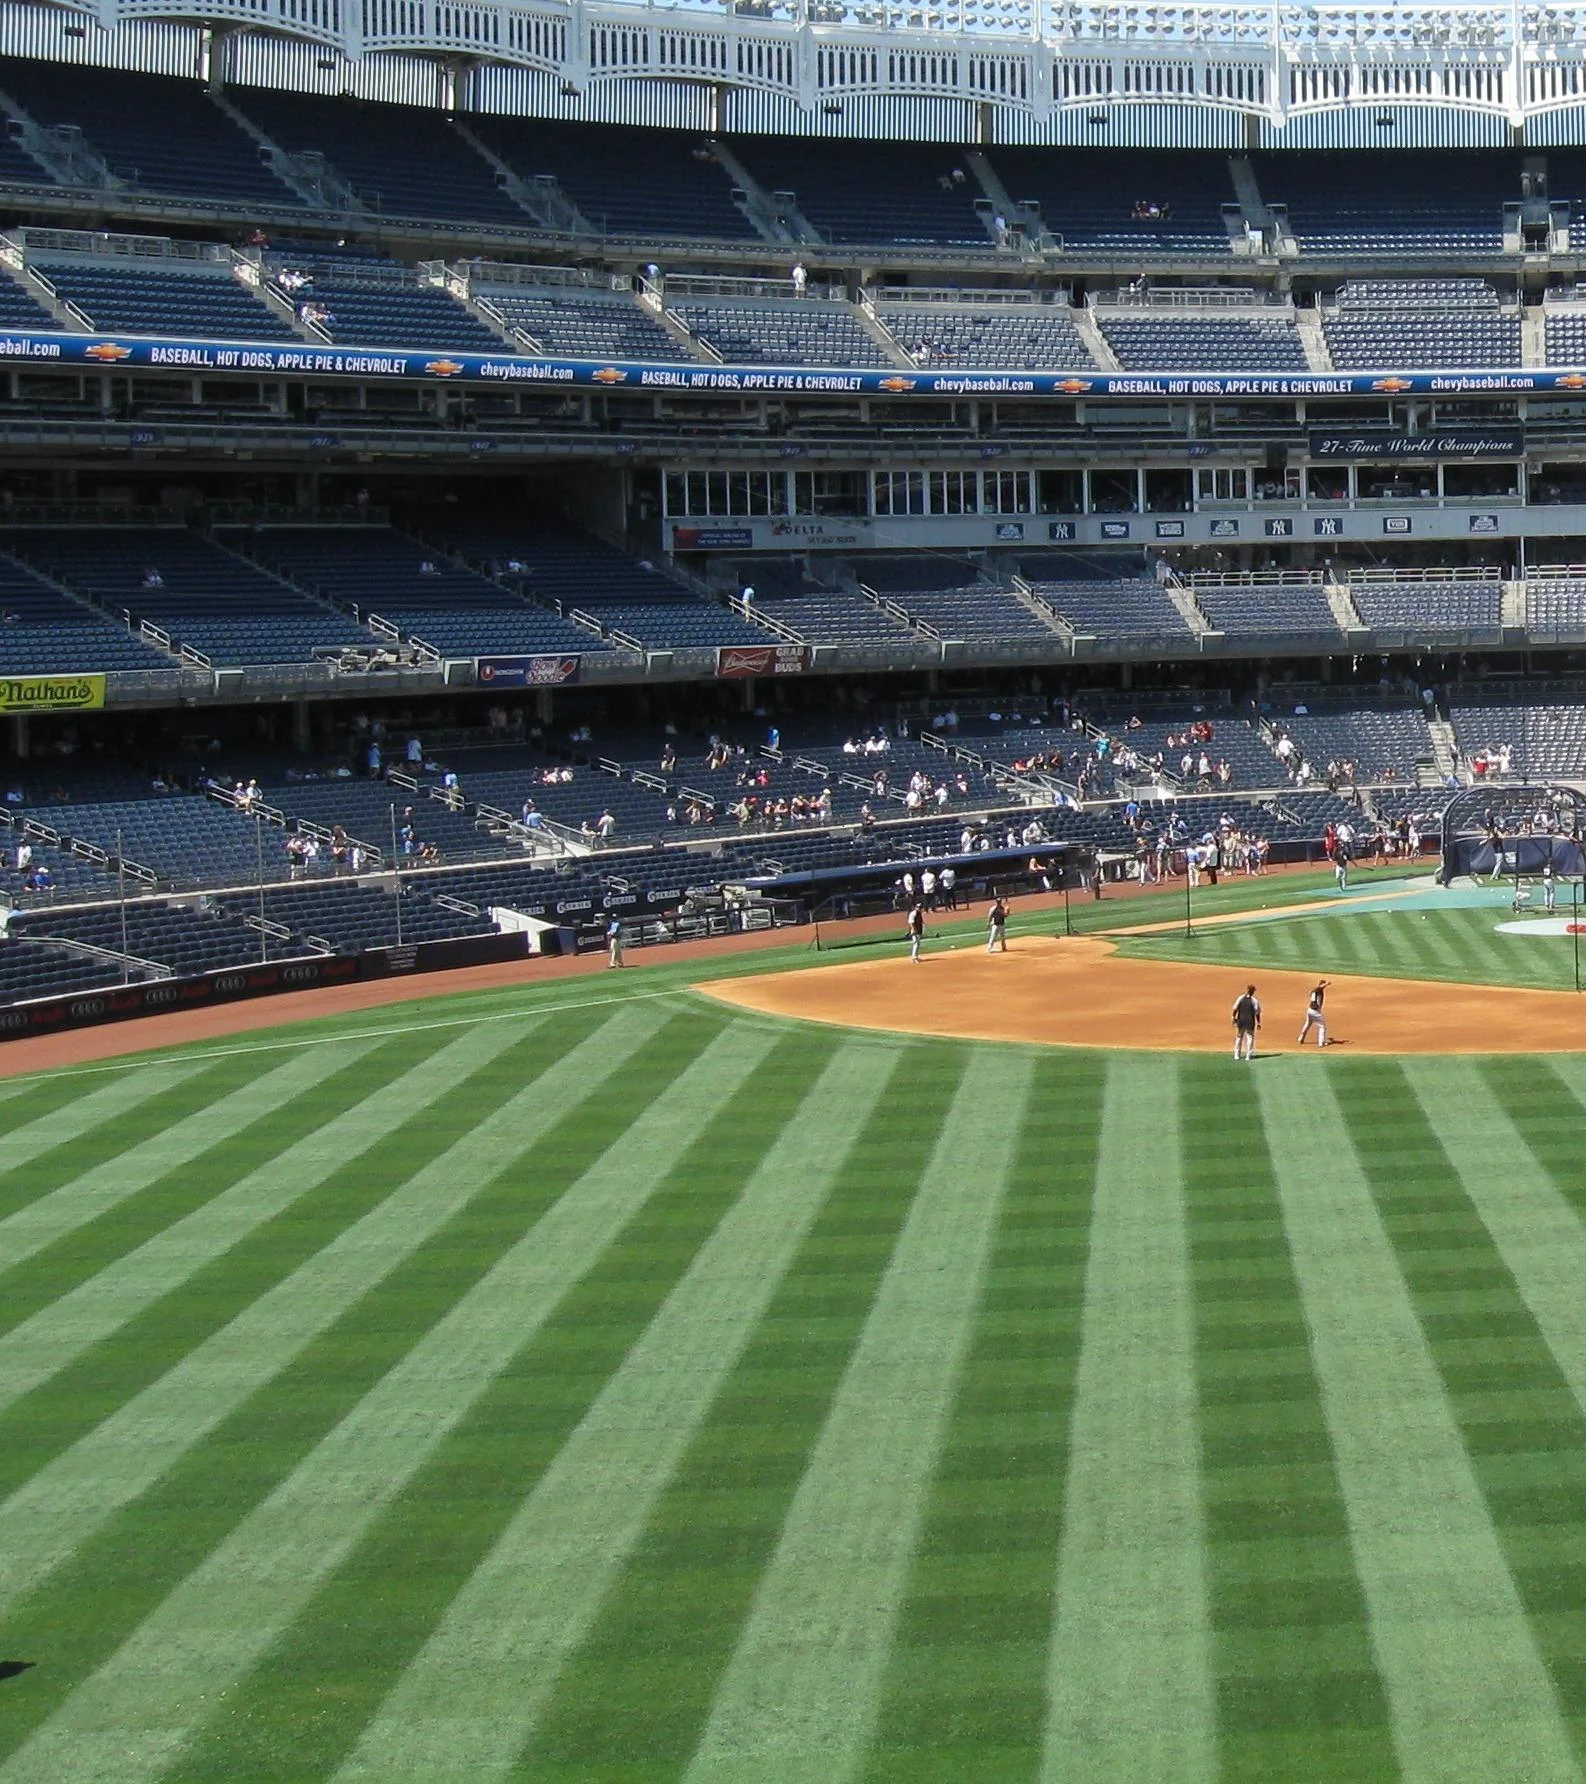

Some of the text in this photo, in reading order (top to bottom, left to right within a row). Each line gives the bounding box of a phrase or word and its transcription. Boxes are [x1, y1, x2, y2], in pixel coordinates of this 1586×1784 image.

[151, 346, 407, 374] BASEBALL, HOT DOGS, APPLE PIE & CHEVROLET
[480, 362, 574, 381] chevybaseball.com
[641, 370, 862, 391] BASEBALL, HOT DOGS, APPLE PIE & CHEVROLET
[934, 377, 1034, 394] chevybaseball.com
[1108, 380, 1353, 395] BASEBALL, HOT DOGS, APPLE PIE & CHEVROLET
[1431, 377, 1534, 394] chevybaseball.com
[1320, 437, 1513, 453] 27-Time World Champions
[785, 525, 824, 535] DELTA
[776, 647, 804, 657] GRAB
[774, 662, 802, 673] BUDS
[0, 679, 93, 702] Nathan's
